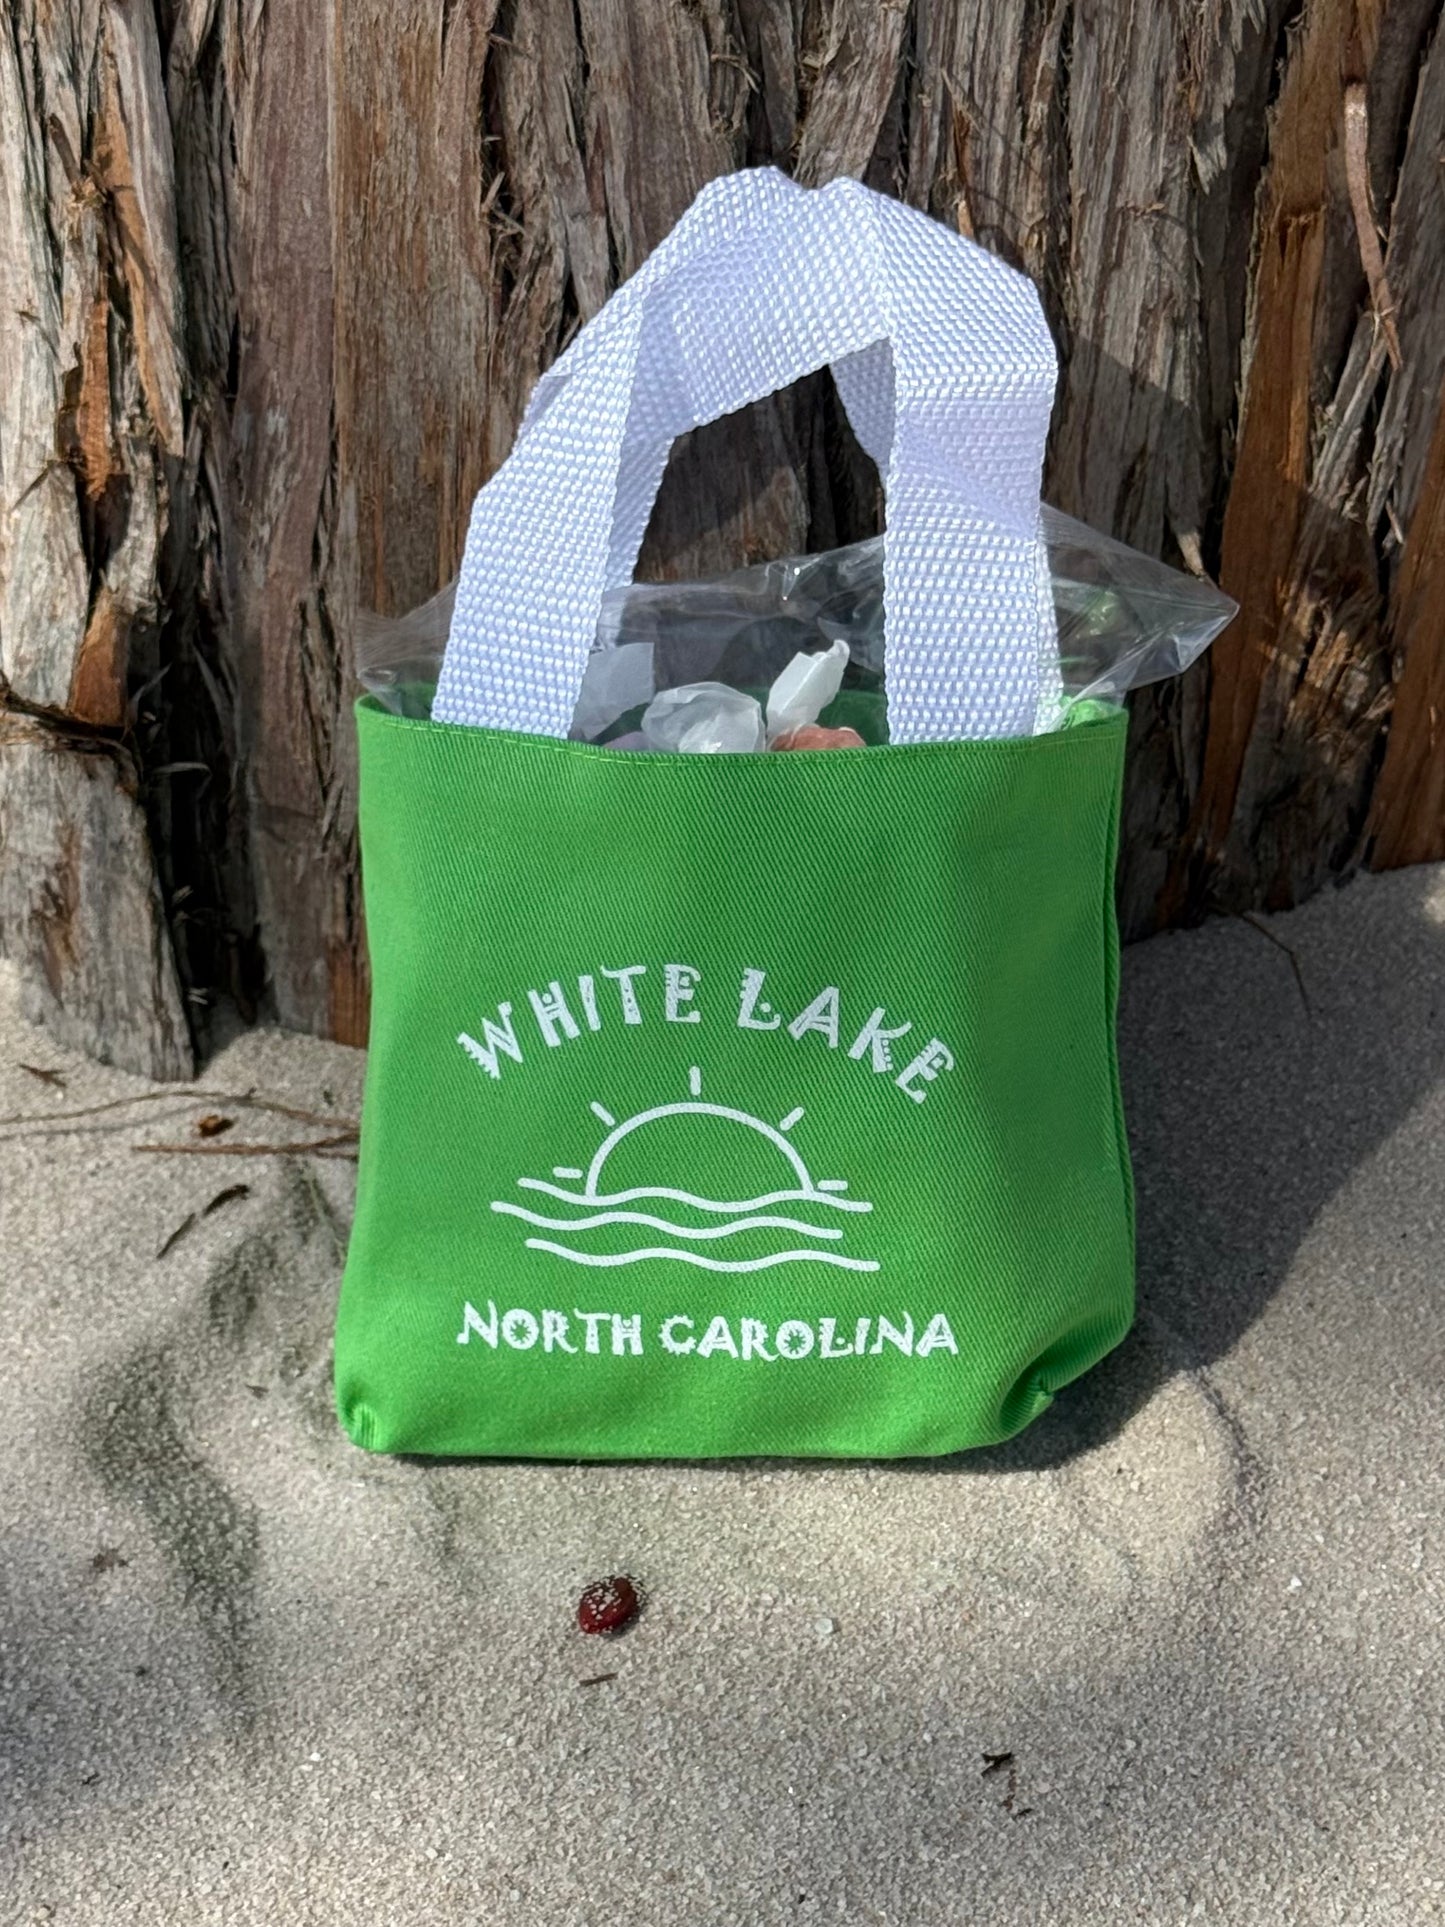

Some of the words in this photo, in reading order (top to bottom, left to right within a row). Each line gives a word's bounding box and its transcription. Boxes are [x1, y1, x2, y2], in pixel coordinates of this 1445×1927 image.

[456, 963, 703, 1080] WHITE
[736, 965, 954, 1104] LAKE
[456, 1299, 644, 1357] NORTH
[658, 1310, 959, 1362] CAROLINA
